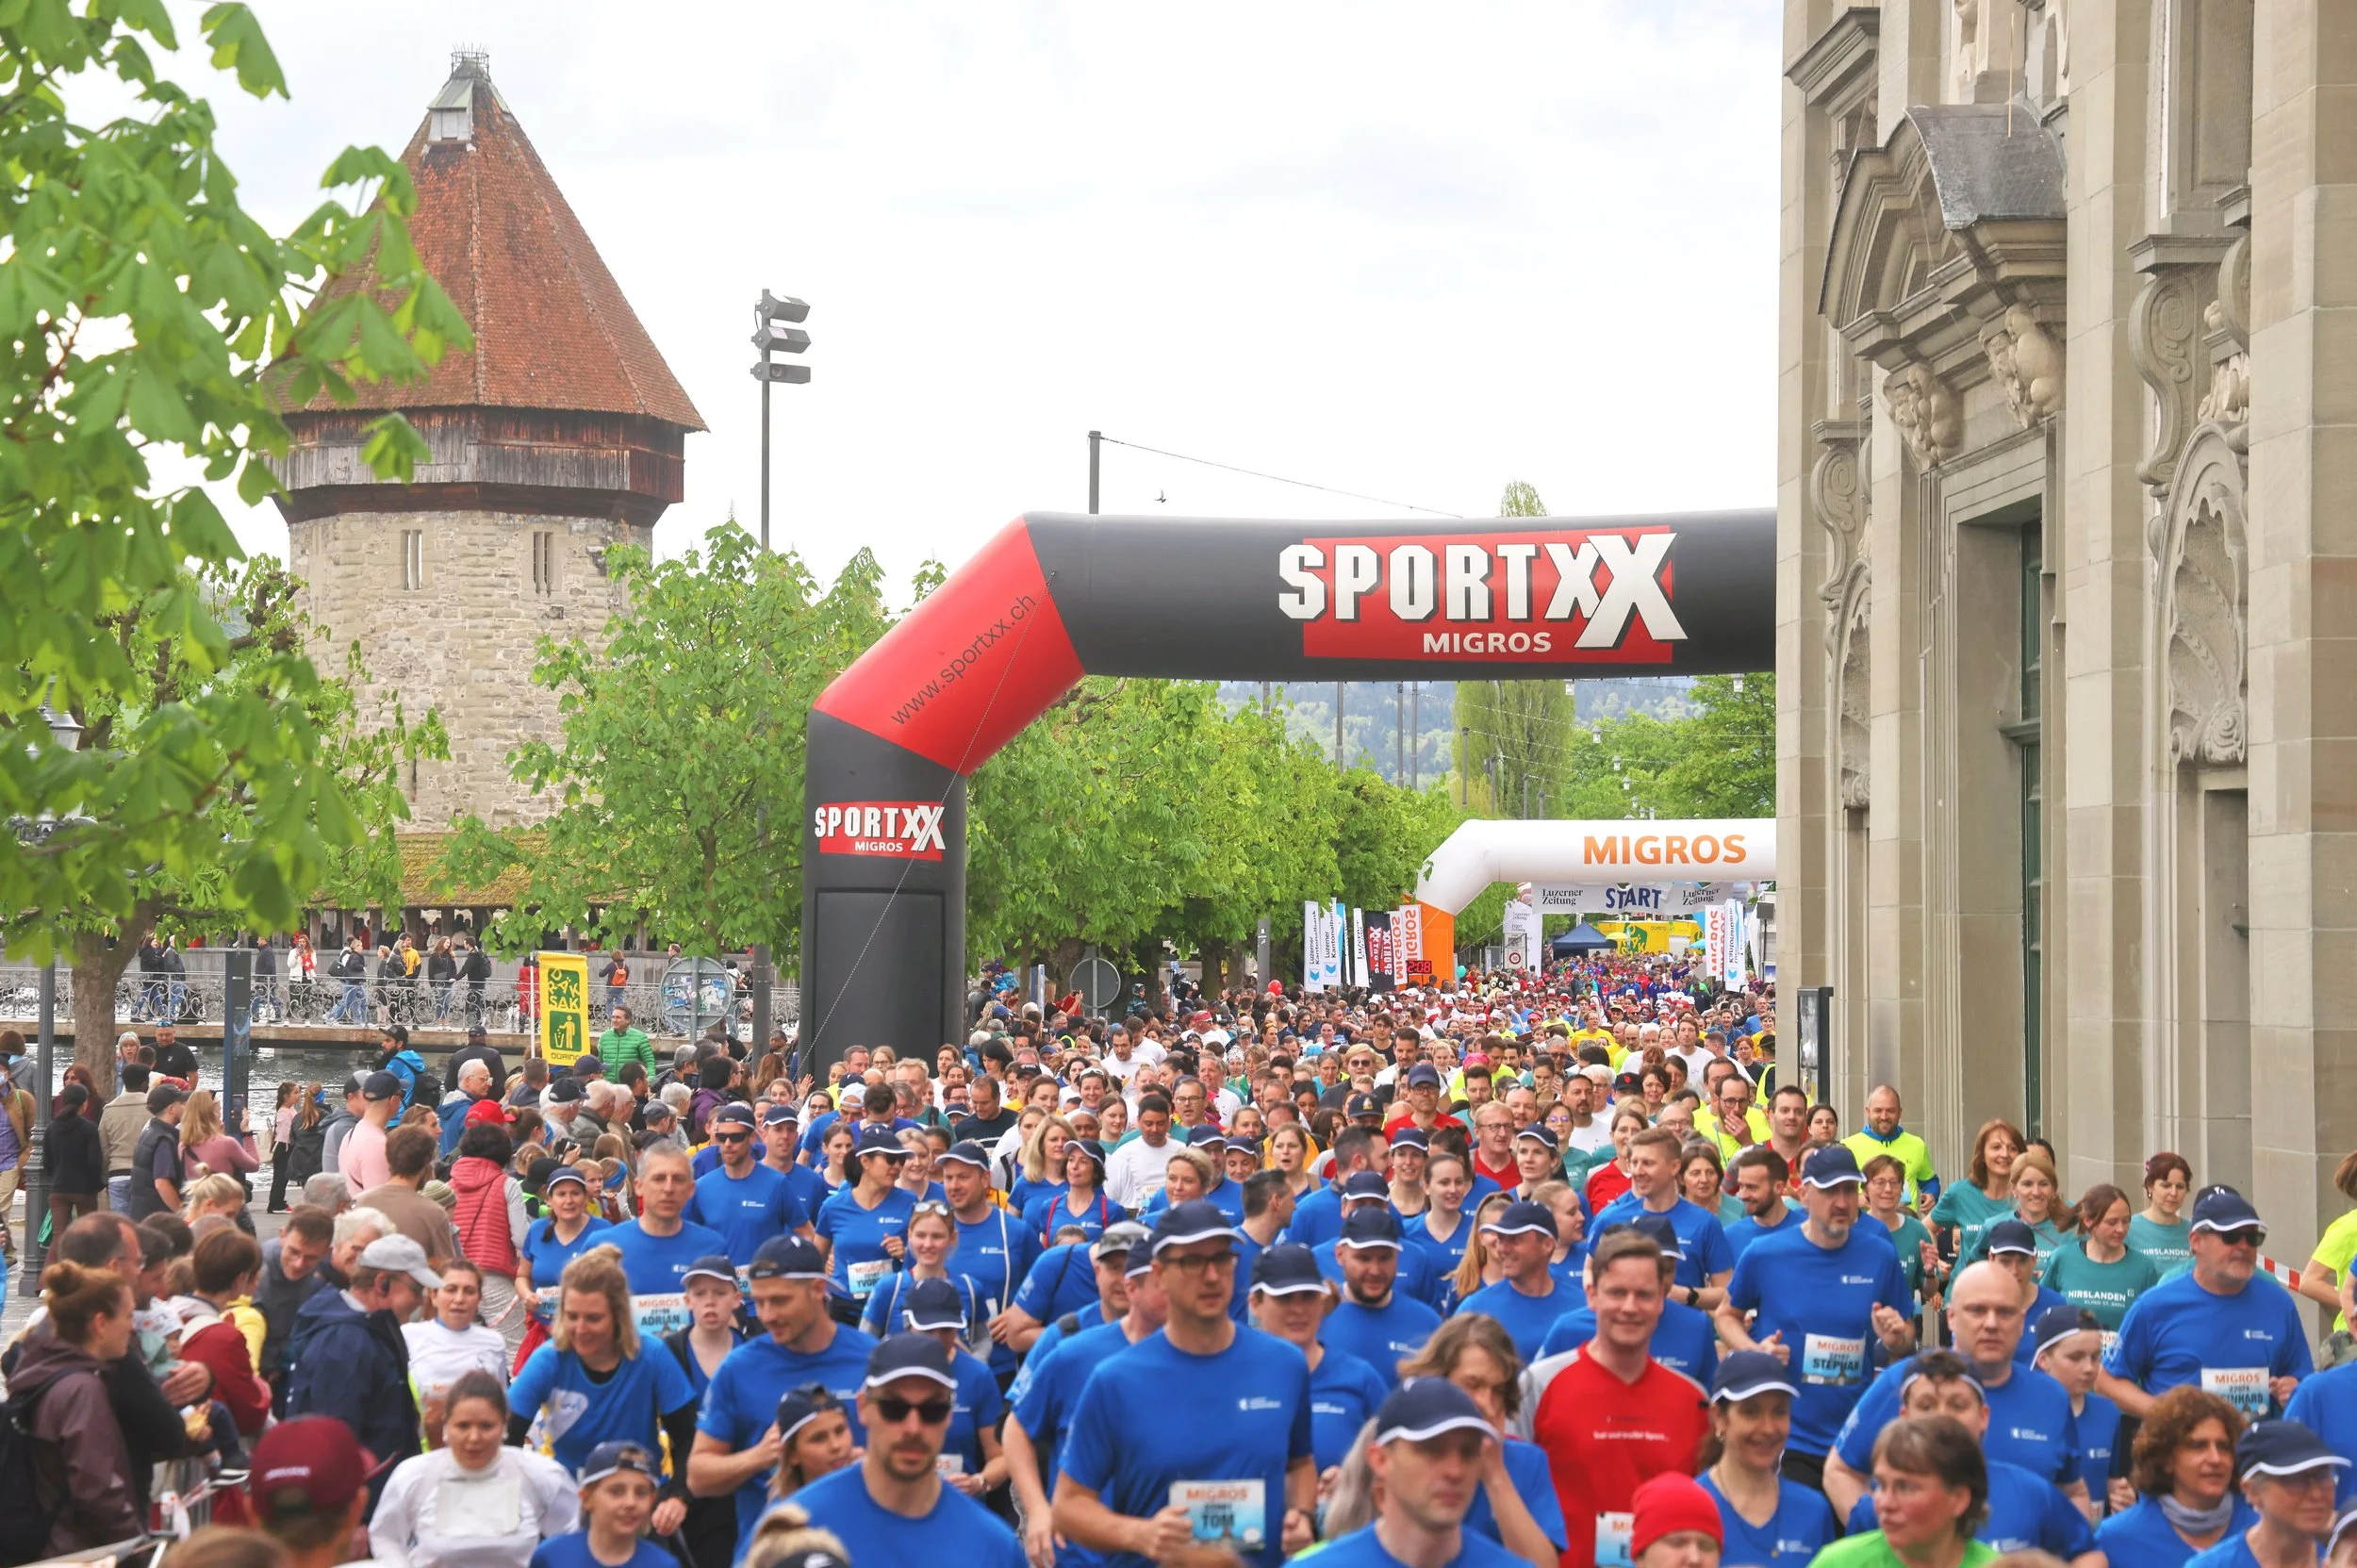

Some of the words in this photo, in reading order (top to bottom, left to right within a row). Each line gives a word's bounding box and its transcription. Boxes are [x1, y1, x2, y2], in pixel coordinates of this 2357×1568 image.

[1278, 533, 1689, 649] SPORTXX
[1423, 632, 1553, 653] MIGROS
[890, 594, 1037, 726] www.sportxx.ch
[815, 805, 947, 851] SPORTXX
[854, 841, 903, 852] MIGROS
[1583, 834, 1747, 866] MIGROS
[1542, 888, 1584, 898] Luzerner
[1606, 887, 1662, 910] START
[1541, 896, 1576, 906] Zeitung
[549, 996, 579, 1010] SAK
[2141, 1247, 2190, 1257] HIRSLANDEN
[854, 1263, 886, 1273] MIGROS
[2068, 1289, 2127, 1302] HIRSLANDEN
[638, 1297, 680, 1309] MIGROS
[641, 1314, 681, 1327] ADRIAN
[1817, 1341, 1860, 1352] MIGROS
[2214, 1373, 2260, 1384] MIGROS
[1186, 1488, 1247, 1500] MIGROS
[1202, 1514, 1235, 1529] TOM
